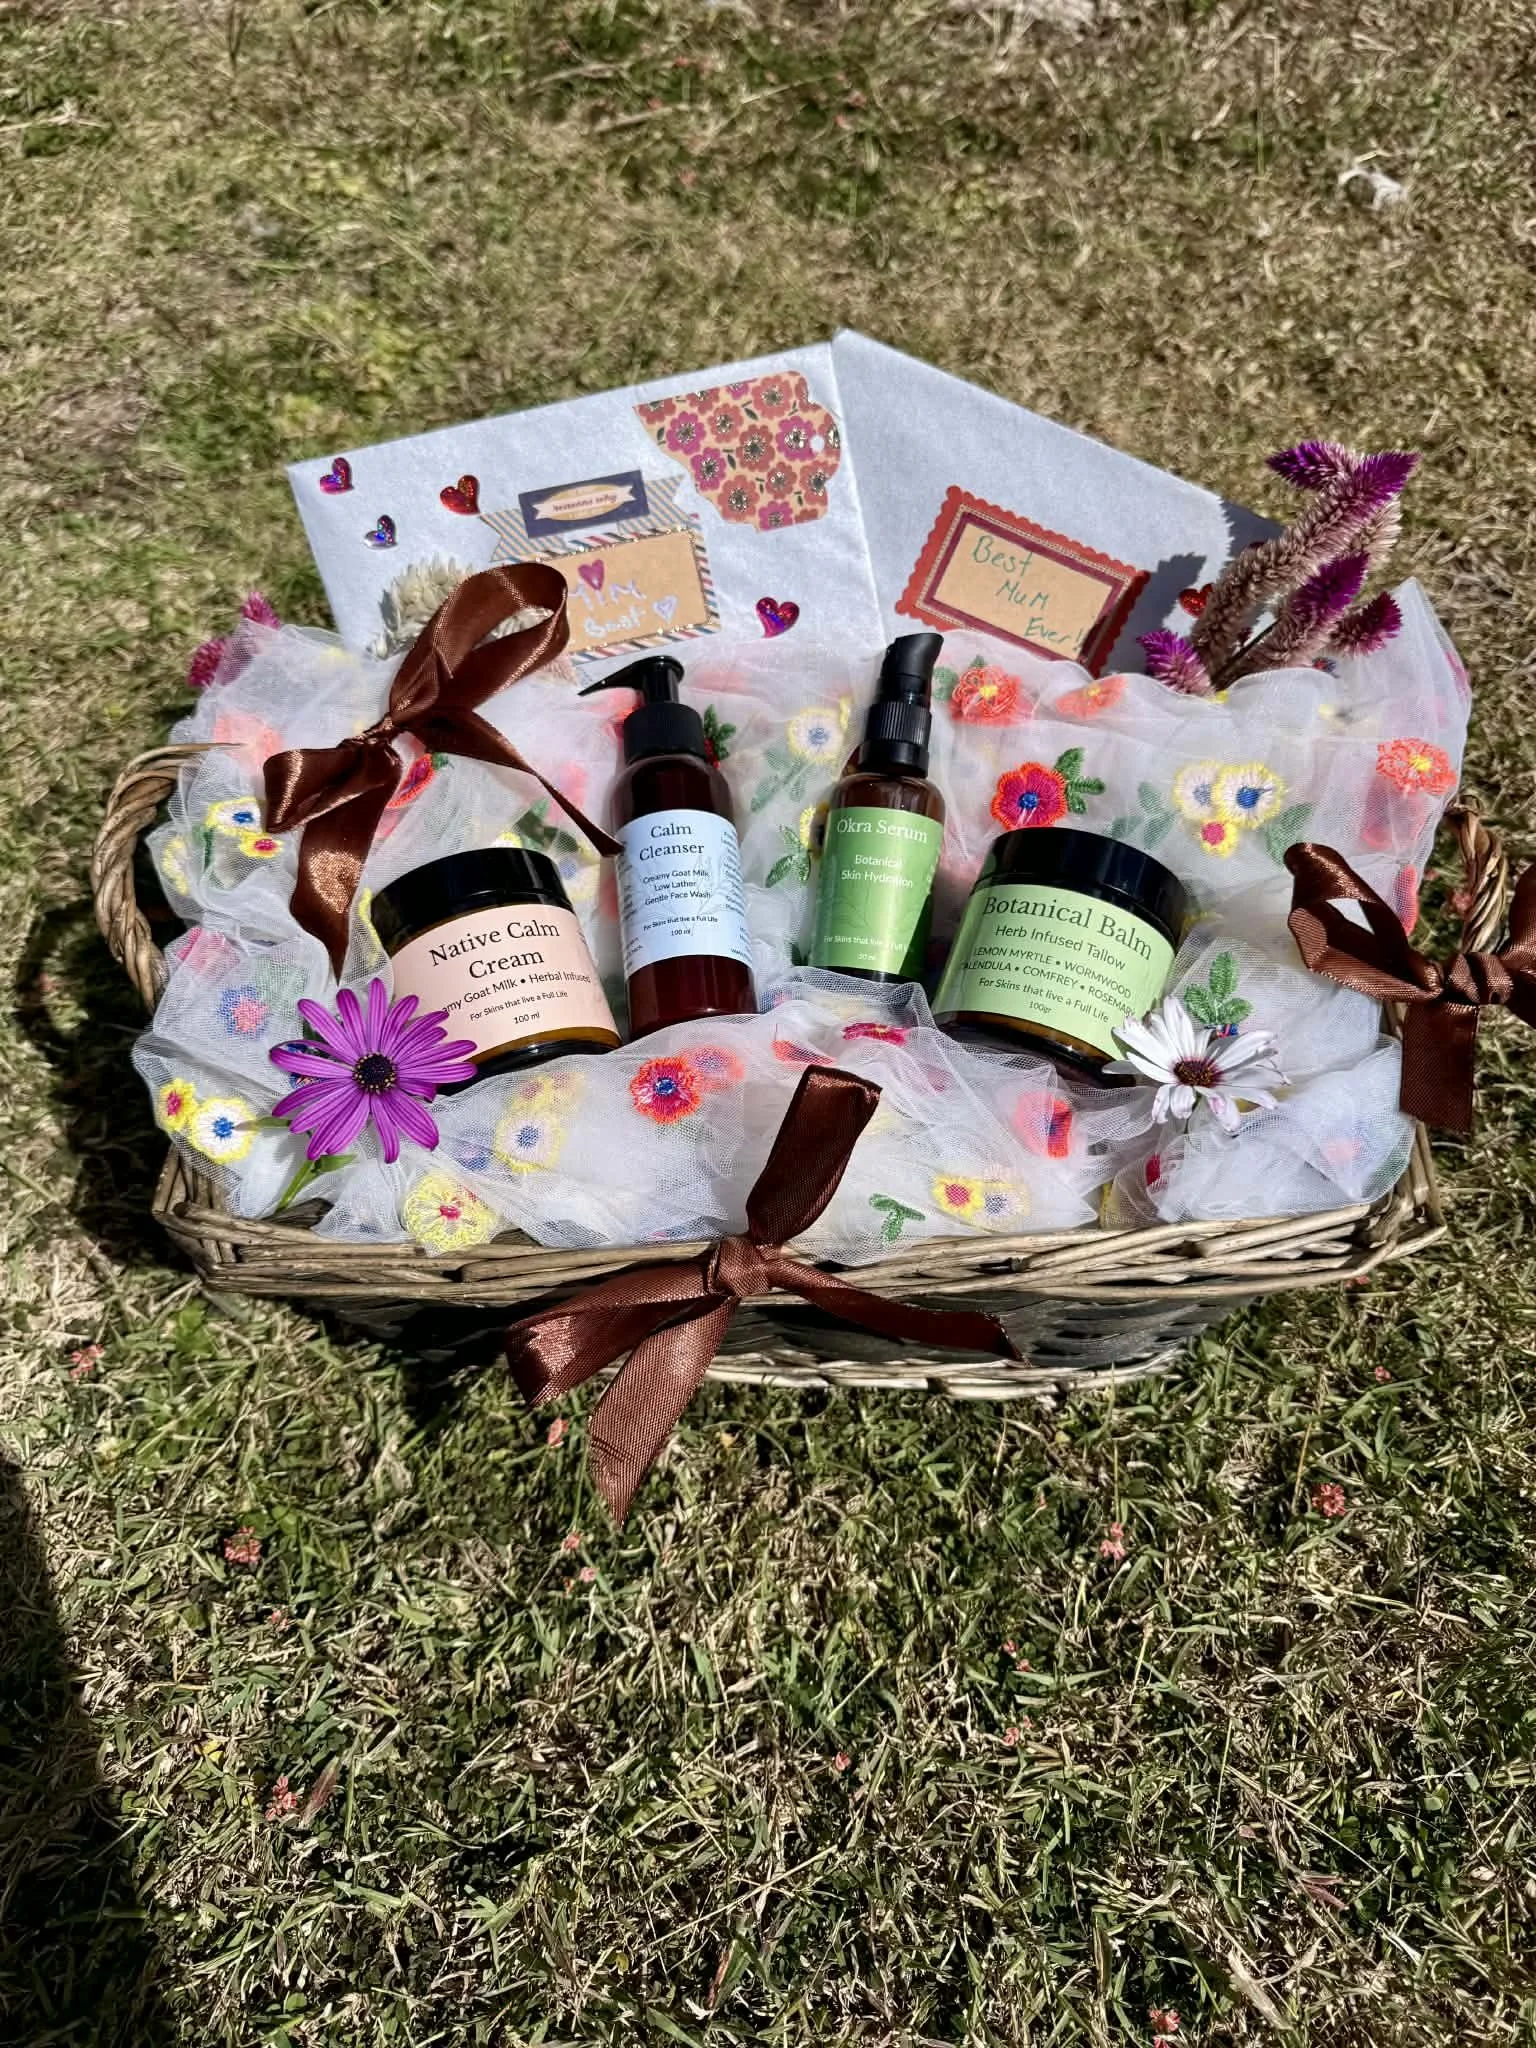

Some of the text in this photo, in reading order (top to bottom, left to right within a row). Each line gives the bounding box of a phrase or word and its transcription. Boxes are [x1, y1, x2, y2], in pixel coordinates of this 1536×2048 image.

[973, 535, 1033, 576] Best
[651, 823, 692, 838] Calm
[837, 818, 928, 844] Okra Serum
[639, 844, 704, 861] Cleanser
[643, 872, 670, 884] Creamy
[654, 880, 697, 891] Low Lather
[841, 869, 860, 880] Skin
[645, 894, 669, 906] Gentle
[690, 890, 711, 898] Wash
[983, 896, 1153, 961] Botanical Balm
[428, 933, 502, 967] Native
[506, 919, 560, 939] Calm
[995, 925, 1126, 971] Herb Infused Tallow
[469, 951, 545, 979] Cream
[974, 946, 1132, 999] LEMON MYRTLE WORMWOOD
[1022, 965, 1078, 989] COMFREY
[463, 986, 492, 1003] Goat
[492, 978, 519, 993] Milk
[528, 971, 563, 984] Herbal
[979, 977, 1109, 1023] For Skins that live a Full Life
[470, 1012, 483, 1022] For
[483, 1004, 504, 1016] Skins
[505, 999, 521, 1009] that
[521, 996, 535, 1004] live
[514, 1011, 540, 1025] 100 ml
